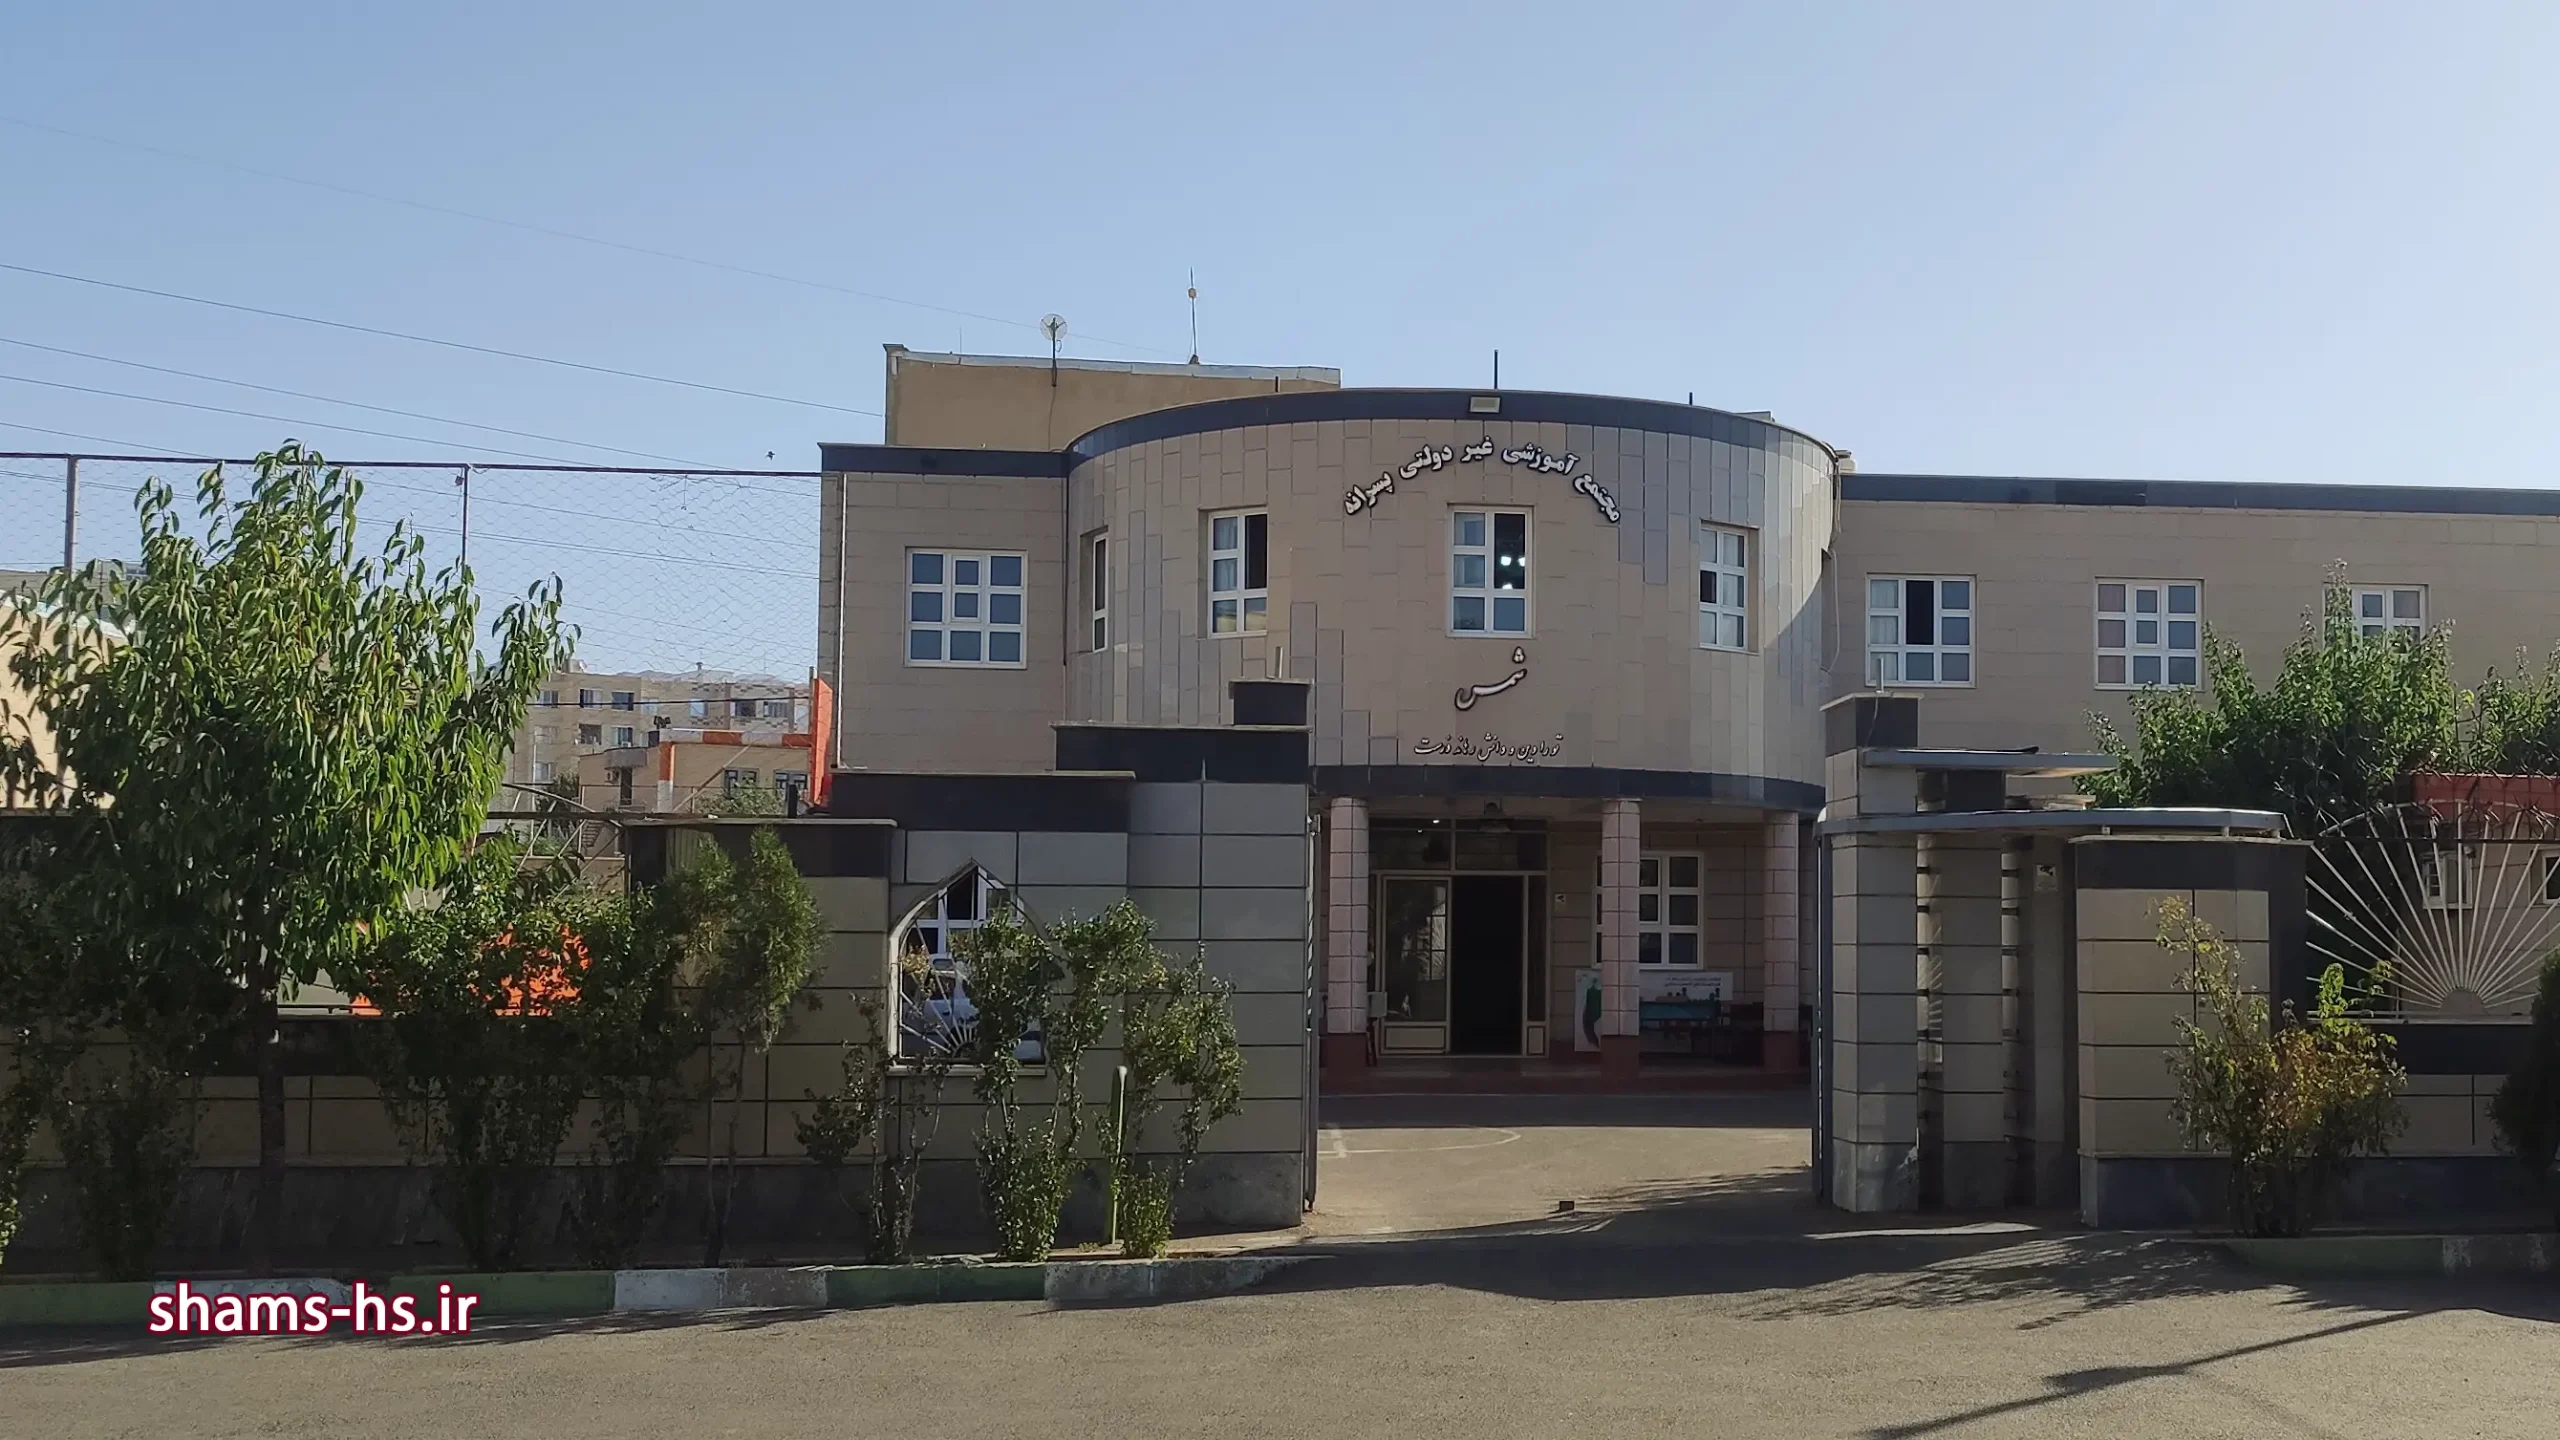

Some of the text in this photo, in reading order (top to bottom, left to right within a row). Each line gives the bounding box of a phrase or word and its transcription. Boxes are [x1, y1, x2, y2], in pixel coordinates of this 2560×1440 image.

[1344, 436, 1620, 522] مجتمع آموزشی غیر دولتی پسرانه
[1454, 646, 1528, 711] شمس
